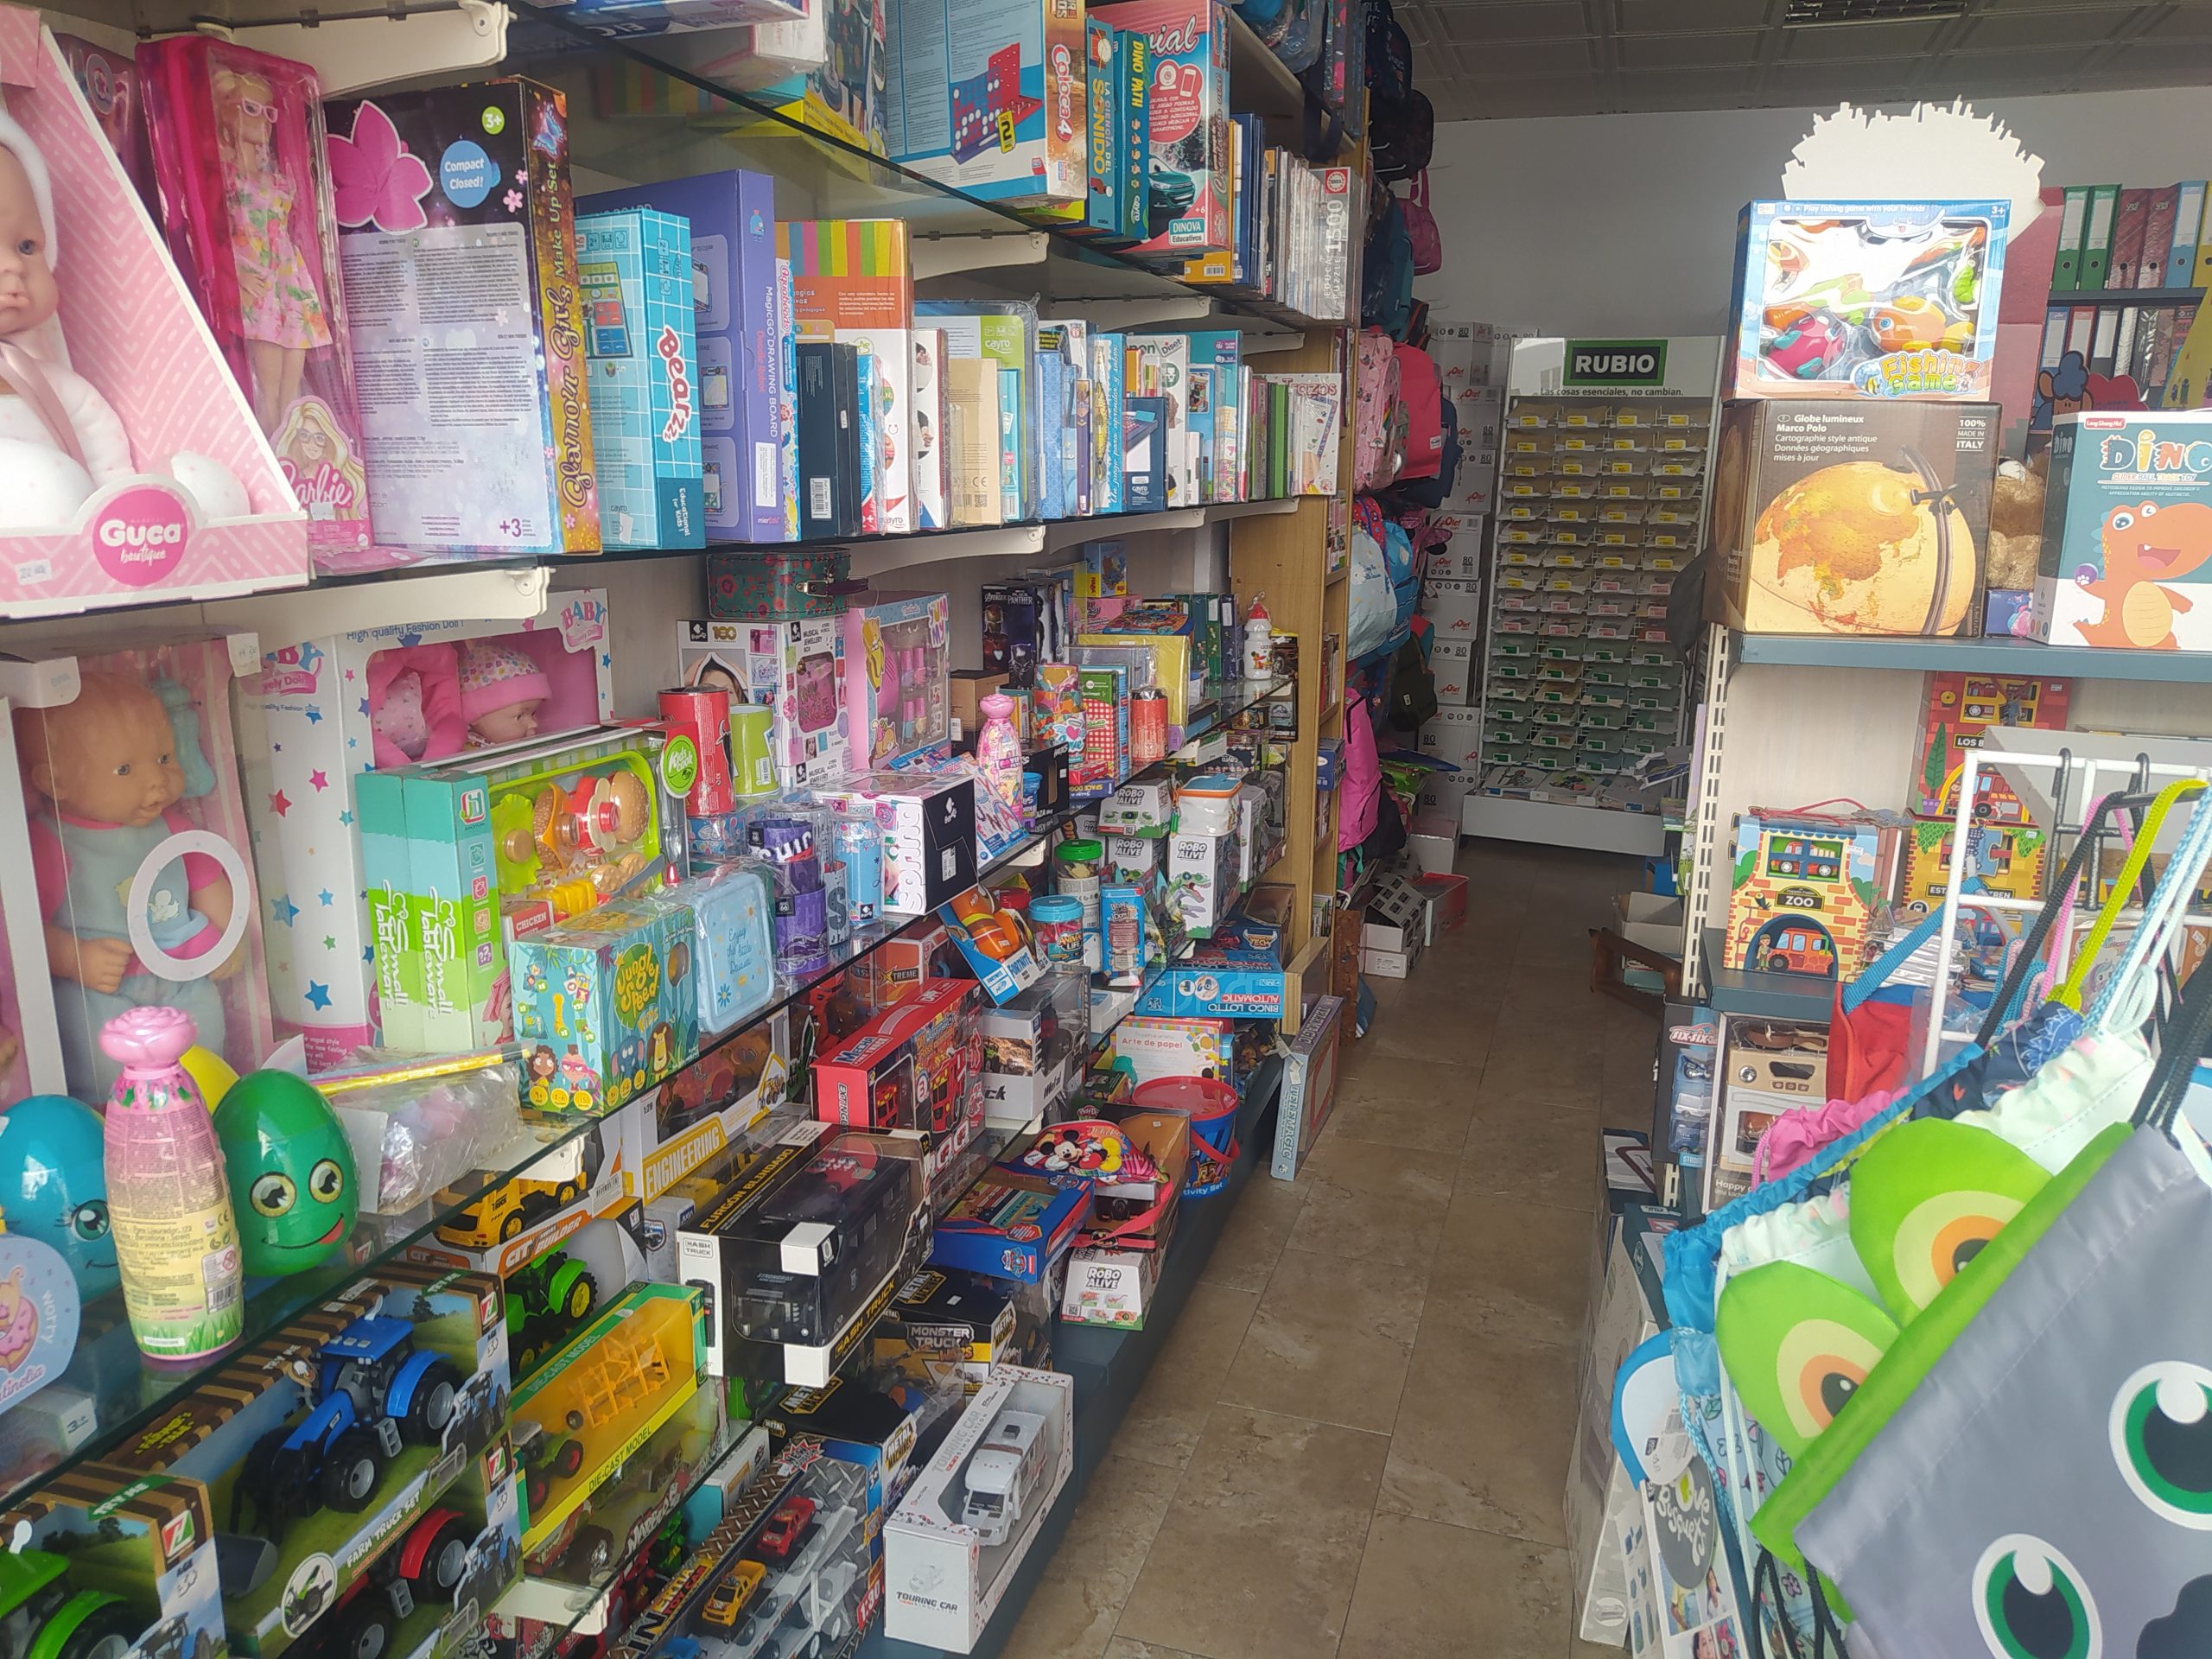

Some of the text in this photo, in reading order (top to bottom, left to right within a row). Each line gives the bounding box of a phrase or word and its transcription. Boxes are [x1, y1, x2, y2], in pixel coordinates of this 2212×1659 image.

[1131, 41, 1144, 107] DINO PATH
[1104, 82, 1110, 97] LA
[485, 113, 502, 129] 3+
[1092, 78, 1105, 175] SONIDO
[445, 158, 484, 172] Compact
[449, 176, 484, 189] Closed!
[547, 163, 558, 191] Set
[550, 195, 563, 222] Up
[1173, 220, 1202, 233] DINOVA
[1325, 200, 1344, 253] 1500
[1172, 232, 1203, 244] Educativos
[551, 230, 565, 279] Make
[1161, 338, 1183, 354] Diset
[766, 339, 777, 394] DRAWING
[1575, 354, 1655, 373] RUBIO
[1879, 350, 1982, 381] Fishing
[1282, 377, 1338, 397] Trazos
[1887, 372, 1959, 395] Game
[1541, 387, 1554, 396] Las
[1556, 388, 1580, 397] cosas
[1582, 387, 1629, 397] esenciales,
[1644, 387, 1684, 397] cambian.
[769, 397, 779, 438] BOARD
[1795, 415, 1821, 423] Globe
[1822, 415, 1865, 423] lumineux
[1959, 419, 1986, 428] 100%
[1777, 423, 1827, 432] Marco Polo
[1775, 434, 1878, 444] Cartographie style antique
[1956, 440, 1985, 449] ITALY
[1774, 443, 1869, 454] Données géographiques
[1802, 454, 1820, 463] jour
[678, 487, 691, 537] Educational
[99, 519, 181, 548] Guca
[499, 518, 522, 537] +3
[120, 543, 167, 566] boutique
[560, 601, 607, 631] BABY
[346, 627, 369, 642] High
[372, 624, 405, 641] quality
[405, 620, 442, 635] Fashion
[442, 619, 460, 631] Doll
[1957, 737, 1976, 747] LOS
[1118, 788, 1144, 798] ROBO
[1117, 797, 1143, 806] ALIVE
[1116, 838, 1144, 849] ROBO
[1178, 842, 1207, 852] ROBO
[1116, 848, 1143, 857] ALIVE
[1177, 850, 1205, 861] ALIVE
[1784, 895, 1814, 907] ZOO
[516, 912, 547, 931] CHICKEN
[617, 942, 660, 992] Jungle
[620, 981, 659, 1018] Speed
[1208, 1003, 1244, 1013] LOTTO
[1122, 1037, 1183, 1051] Arte de papel
[1282, 1085, 1300, 1160] TELEMAGIC
[646, 1125, 721, 1199] ENGINEERING
[743, 1147, 795, 1192] BLINDADO
[1715, 1179, 1746, 1192] Happy
[700, 1189, 742, 1229] FURGÓN
[535, 1216, 582, 1255] BUILDER
[686, 1246, 711, 1257] TRUCK
[1087, 1266, 1122, 1280] ROBO
[1086, 1277, 1122, 1290] ALIVE
[911, 1325, 971, 1338] MONSTER
[914, 1337, 961, 1348] TRUCK
[588, 1425, 652, 1493] DIE-CAST MODEL
[346, 1537, 372, 1568] FARM
[374, 1511, 404, 1541] TRUCK
[404, 1491, 421, 1515] SET
[896, 1591, 959, 1612] TOURING CAR
